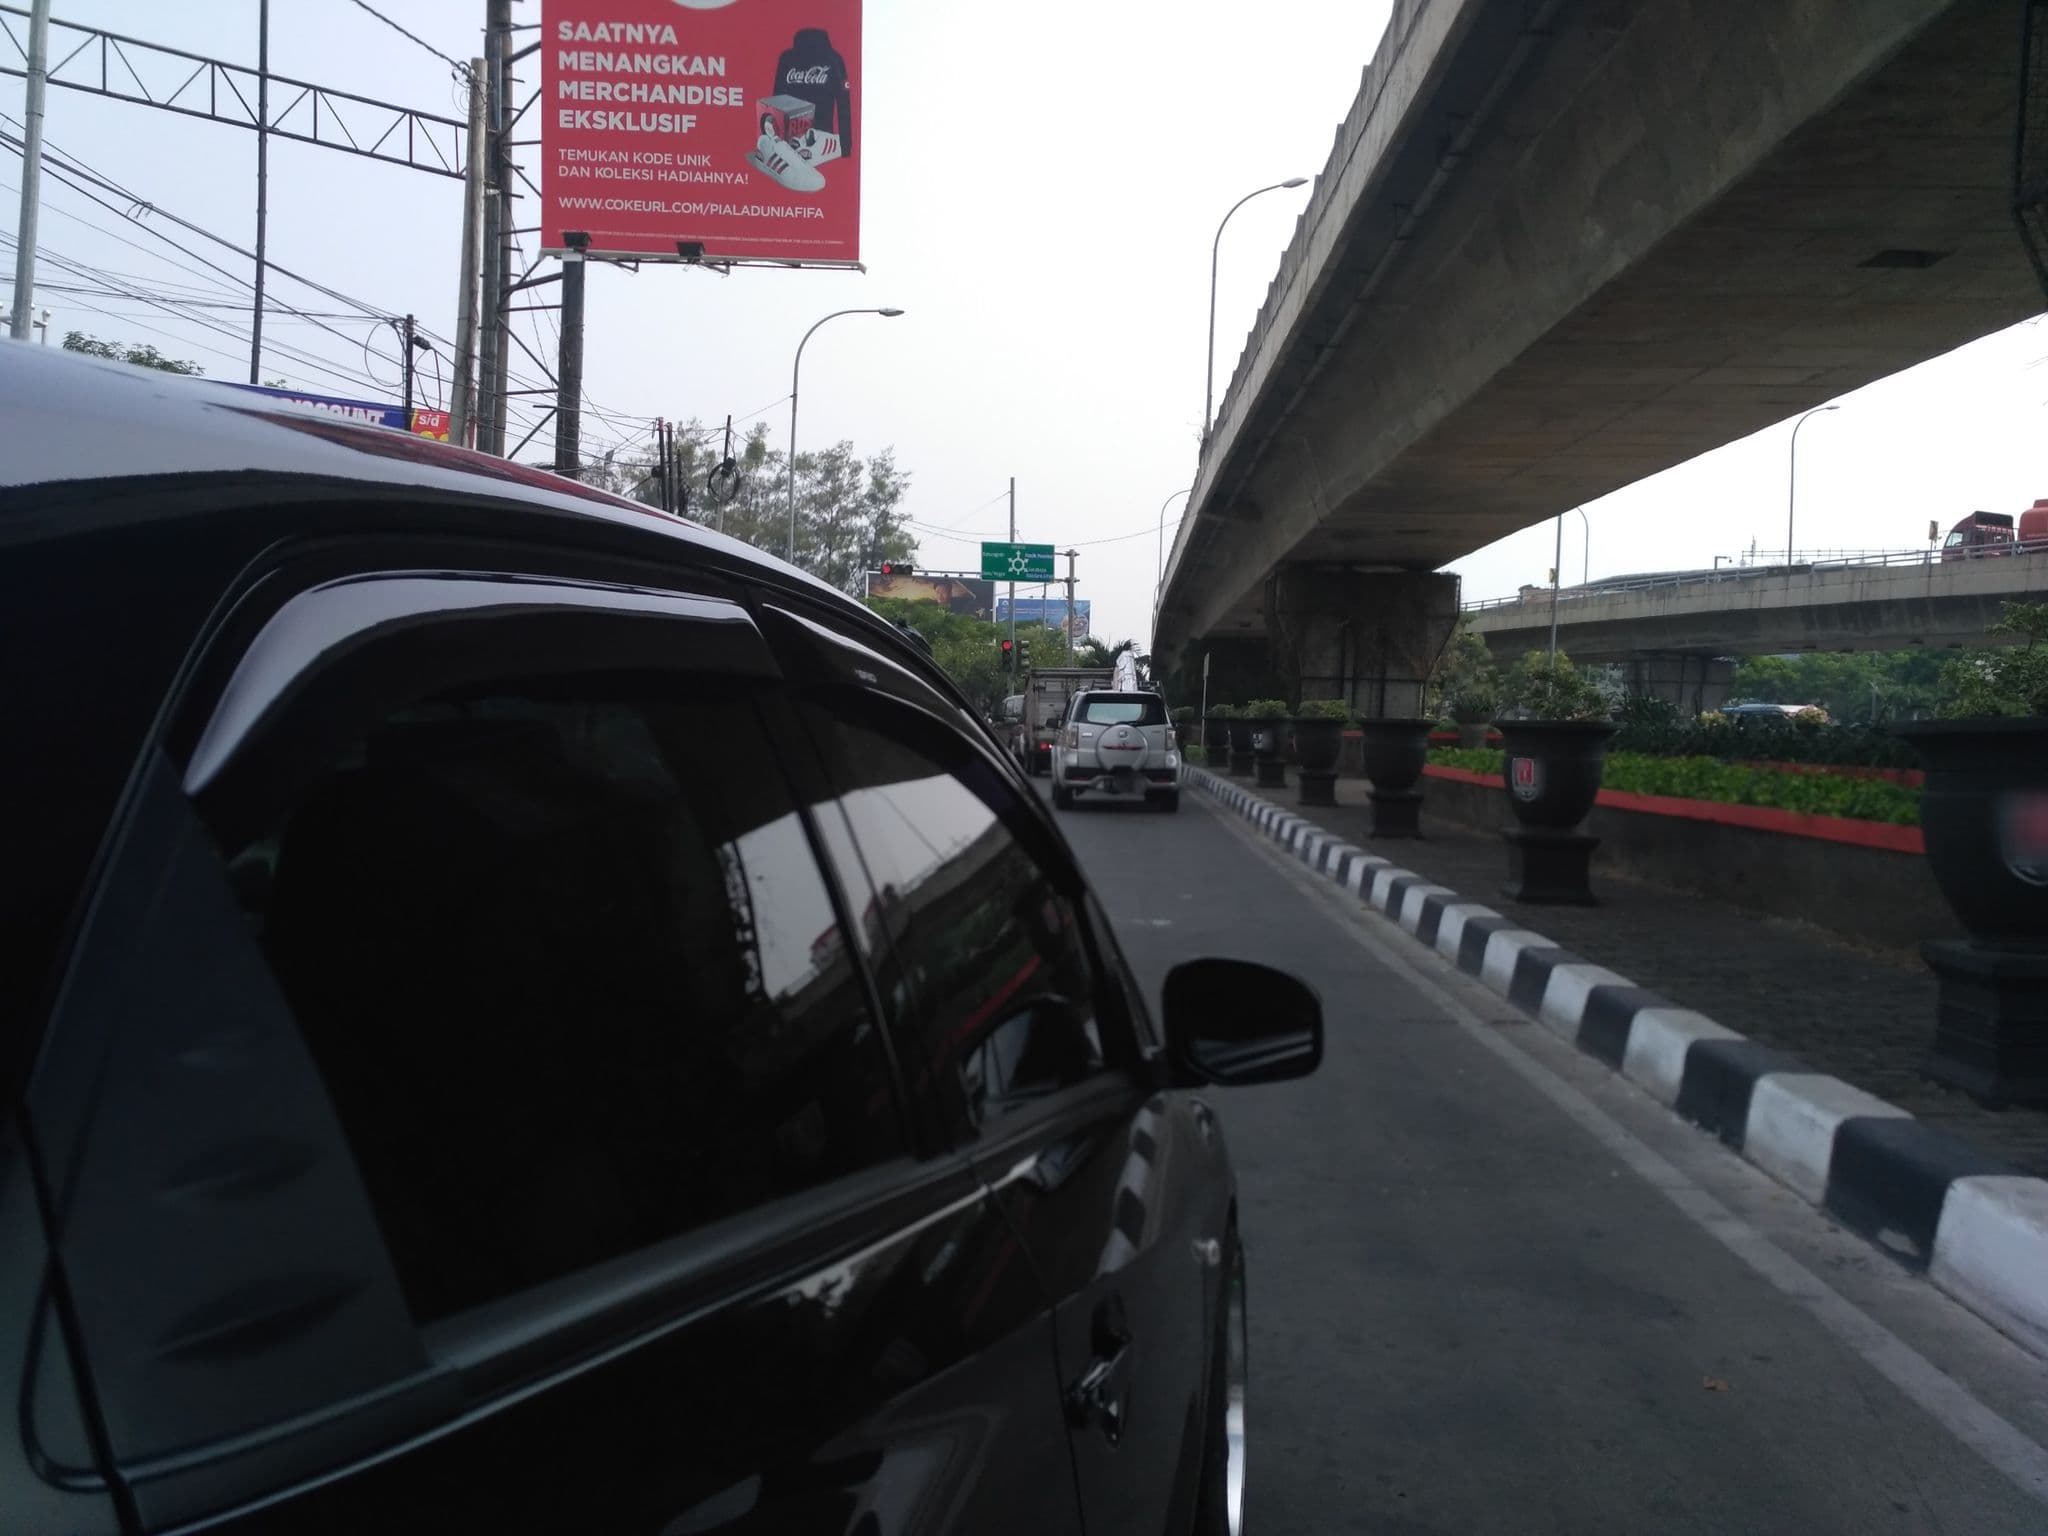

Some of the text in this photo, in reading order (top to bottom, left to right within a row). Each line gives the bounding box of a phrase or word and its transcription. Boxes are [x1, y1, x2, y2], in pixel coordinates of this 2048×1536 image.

[558, 21, 678, 45] SAATNYA
[558, 51, 726, 77] MENANGKAN
[558, 81, 744, 107] MERCHANDISE
[558, 110, 697, 134] EKSKLUSIF
[558, 149, 711, 167] TEMUKAN KODE UNIK
[558, 165, 749, 185] DAN KOLEKSI HADIAHNYA!
[558, 197, 824, 219] WWW.COKEURL.COM/PIALADUNIAFIFA
